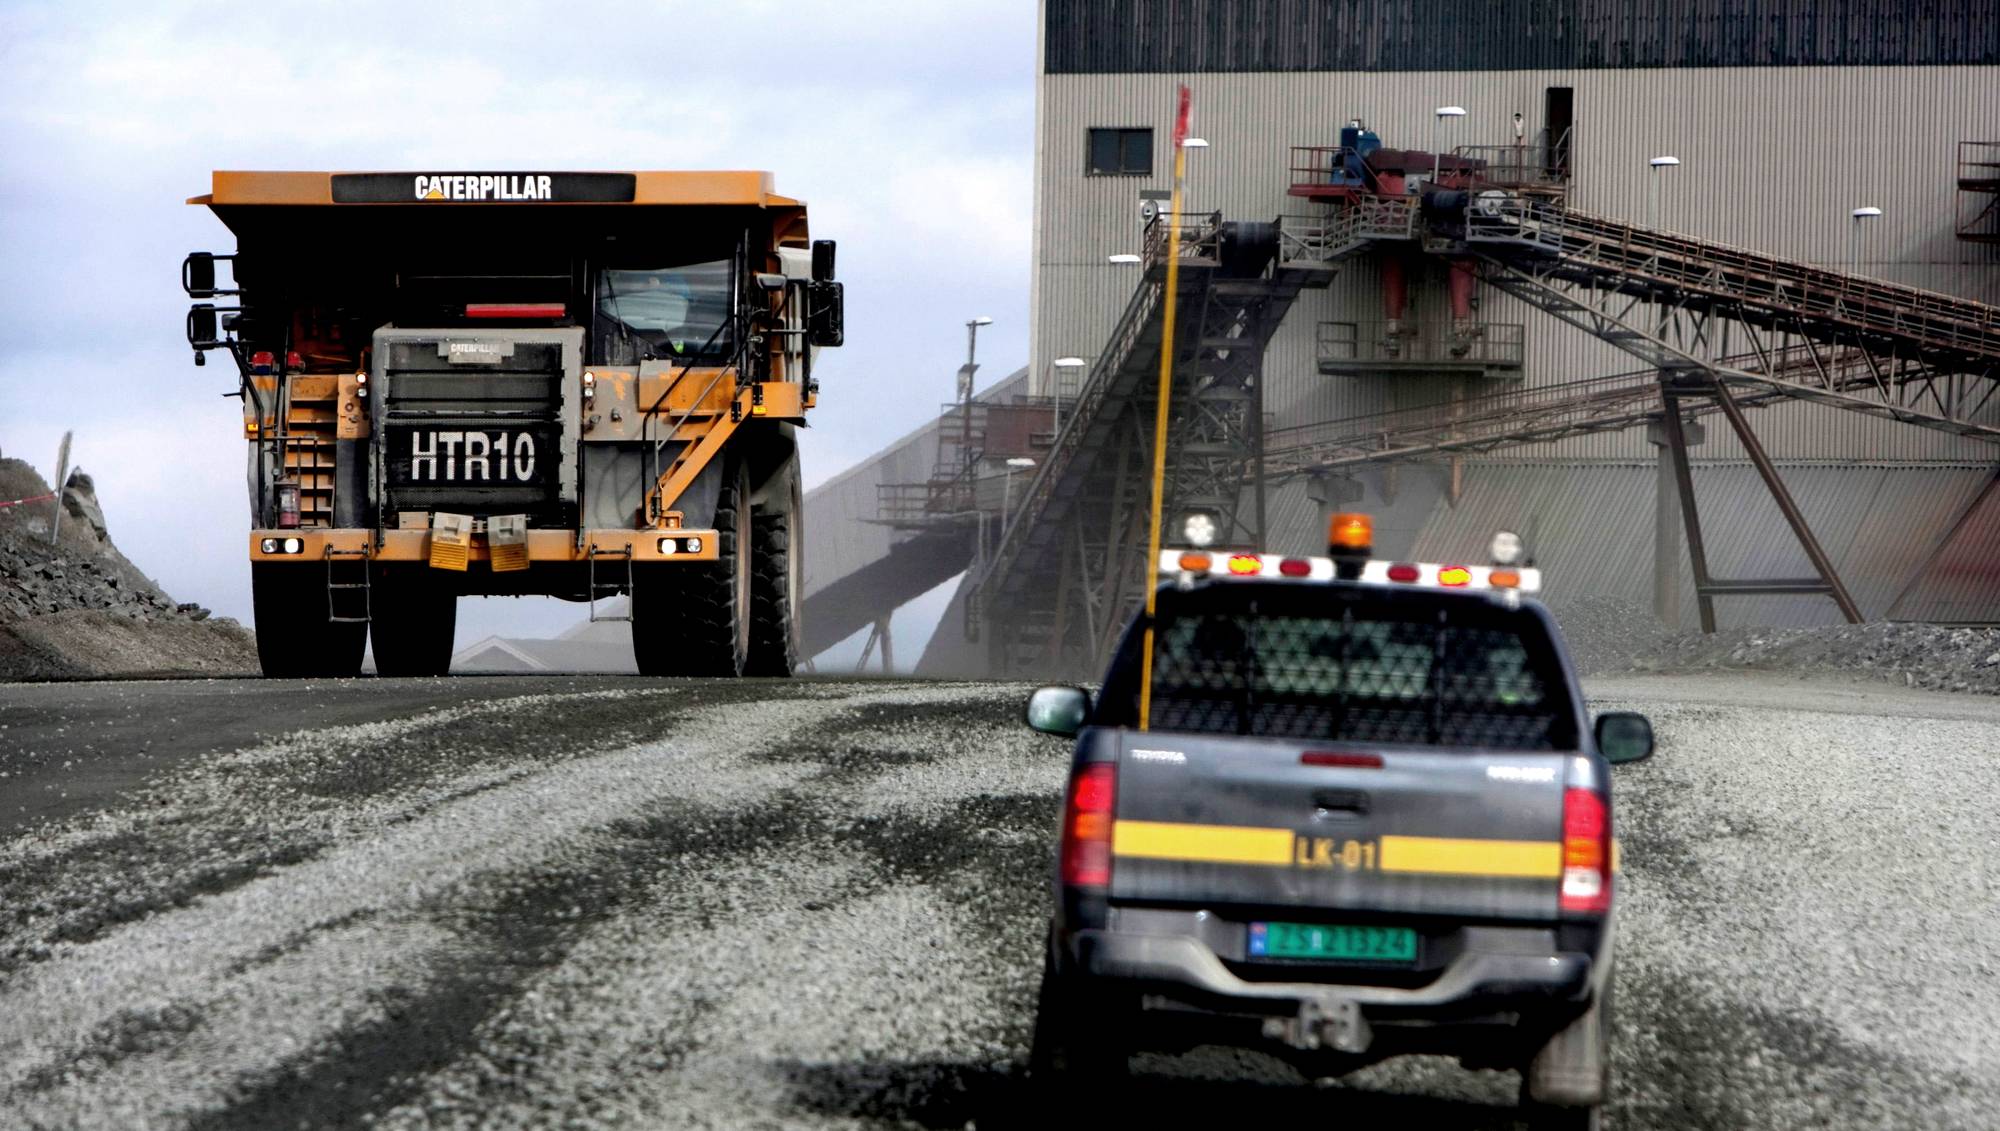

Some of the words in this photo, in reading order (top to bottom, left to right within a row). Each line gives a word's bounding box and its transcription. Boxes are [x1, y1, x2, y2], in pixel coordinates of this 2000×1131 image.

[415, 176, 551, 199] CATERPILLAR
[412, 431, 535, 481] HTR10
[1297, 836, 1376, 870] LK-01
